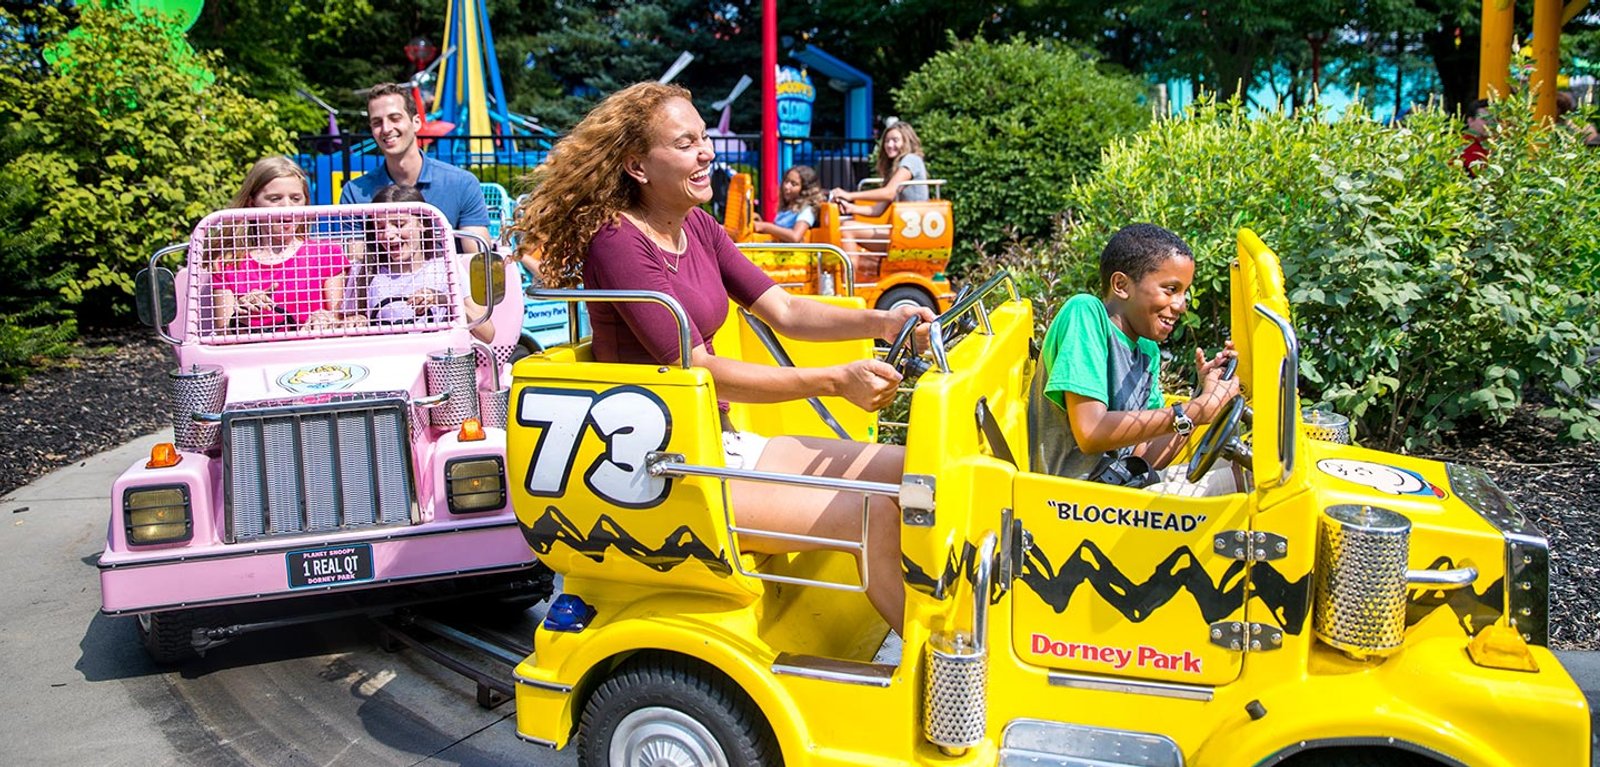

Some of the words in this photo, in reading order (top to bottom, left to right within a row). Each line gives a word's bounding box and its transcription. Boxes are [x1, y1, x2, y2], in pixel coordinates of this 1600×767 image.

[900, 210, 946, 238] 30
[528, 309, 552, 319] Dorney
[553, 307, 567, 316] Park
[516, 385, 673, 509] 73
[1047, 500, 1207, 532] "BLOCKHEAD"
[303, 551, 327, 559] PLANET
[329, 548, 355, 556] SNOOPY
[303, 561, 311, 577] 1
[313, 558, 342, 576] REAL
[344, 556, 358, 574] QT
[308, 576, 336, 584] DORNEY
[1031, 634, 1132, 669] Dorney
[1137, 646, 1202, 673] Park
